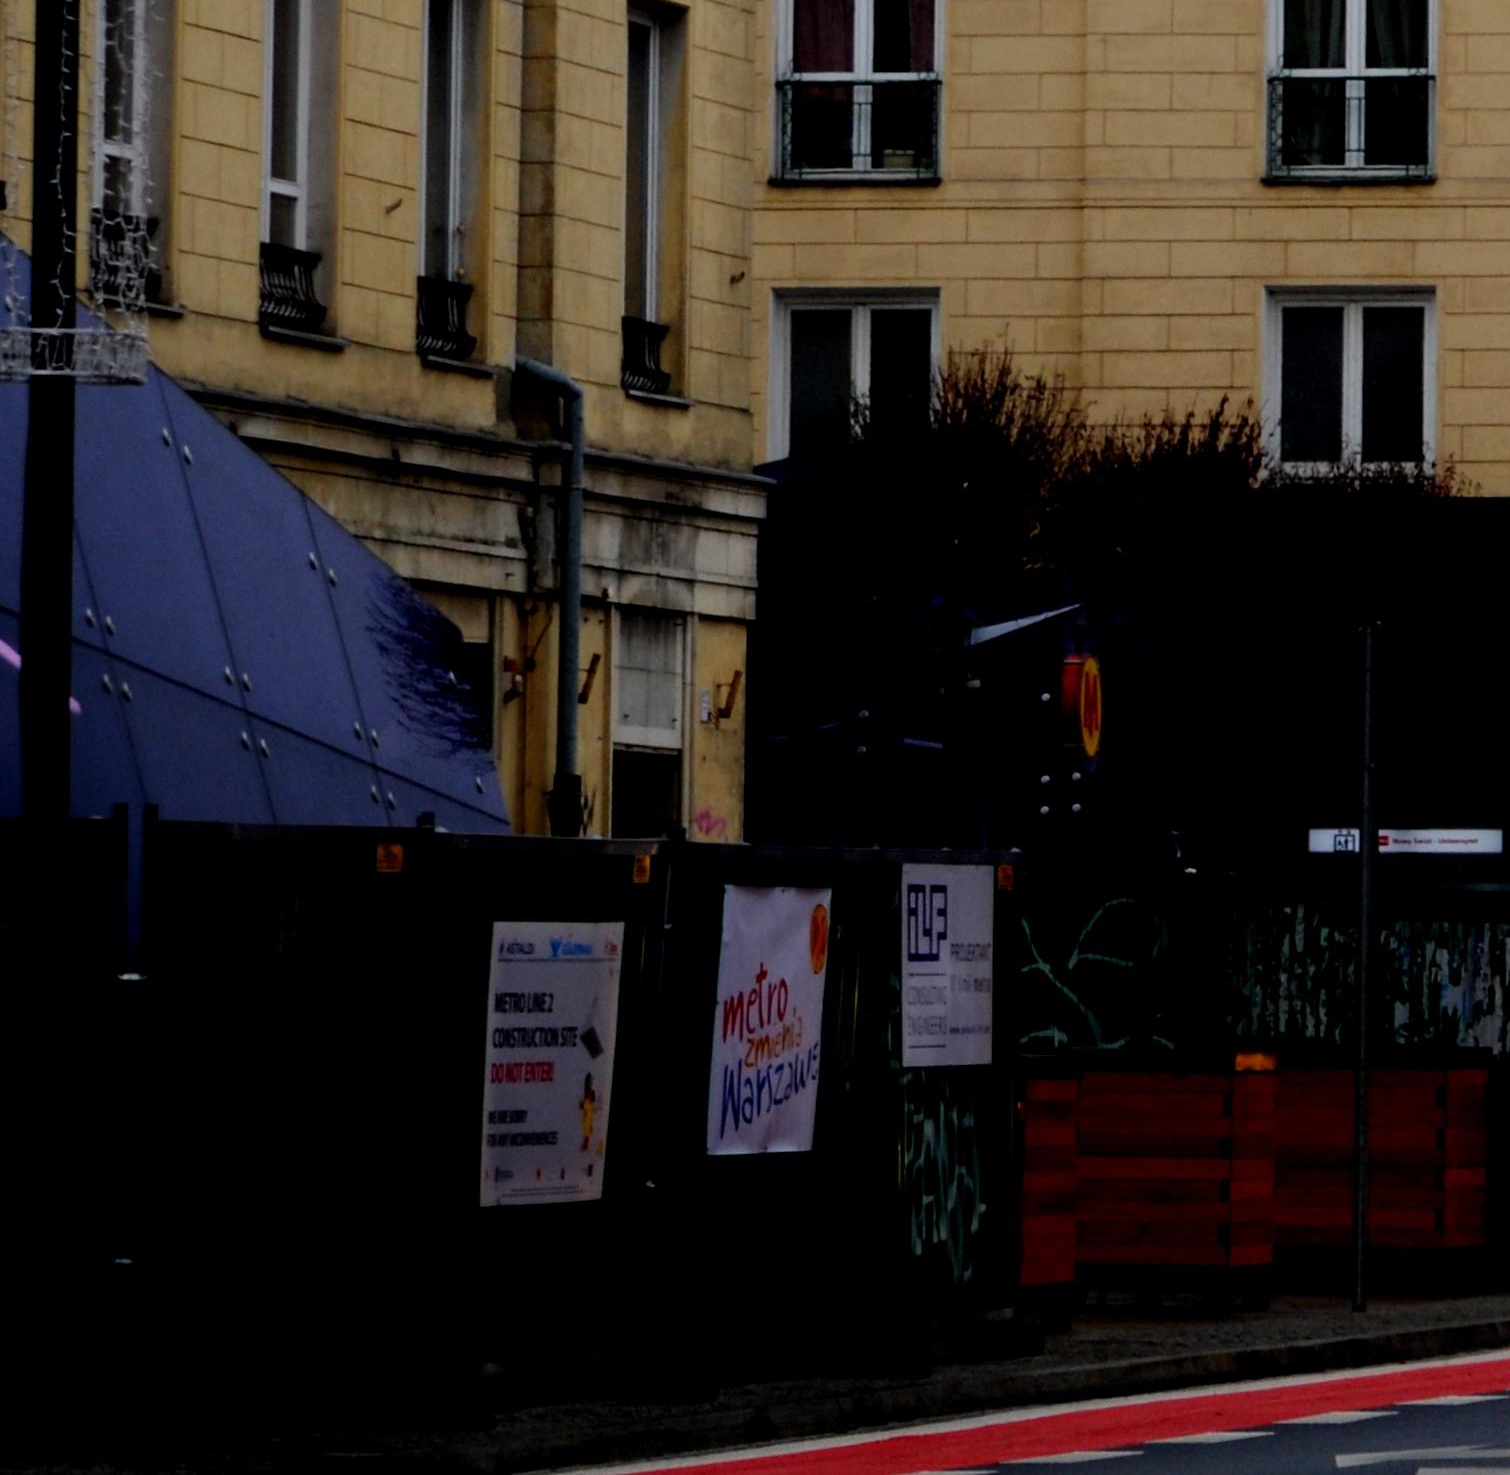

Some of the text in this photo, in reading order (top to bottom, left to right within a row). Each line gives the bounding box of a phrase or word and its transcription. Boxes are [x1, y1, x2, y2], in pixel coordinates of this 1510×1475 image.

[495, 992, 554, 1013] METRO LINE 2
[722, 962, 788, 1044] metro
[493, 1027, 578, 1048] CONSTRUCTION SITE
[491, 1063, 504, 1084] DO
[505, 1062, 524, 1083] NOT
